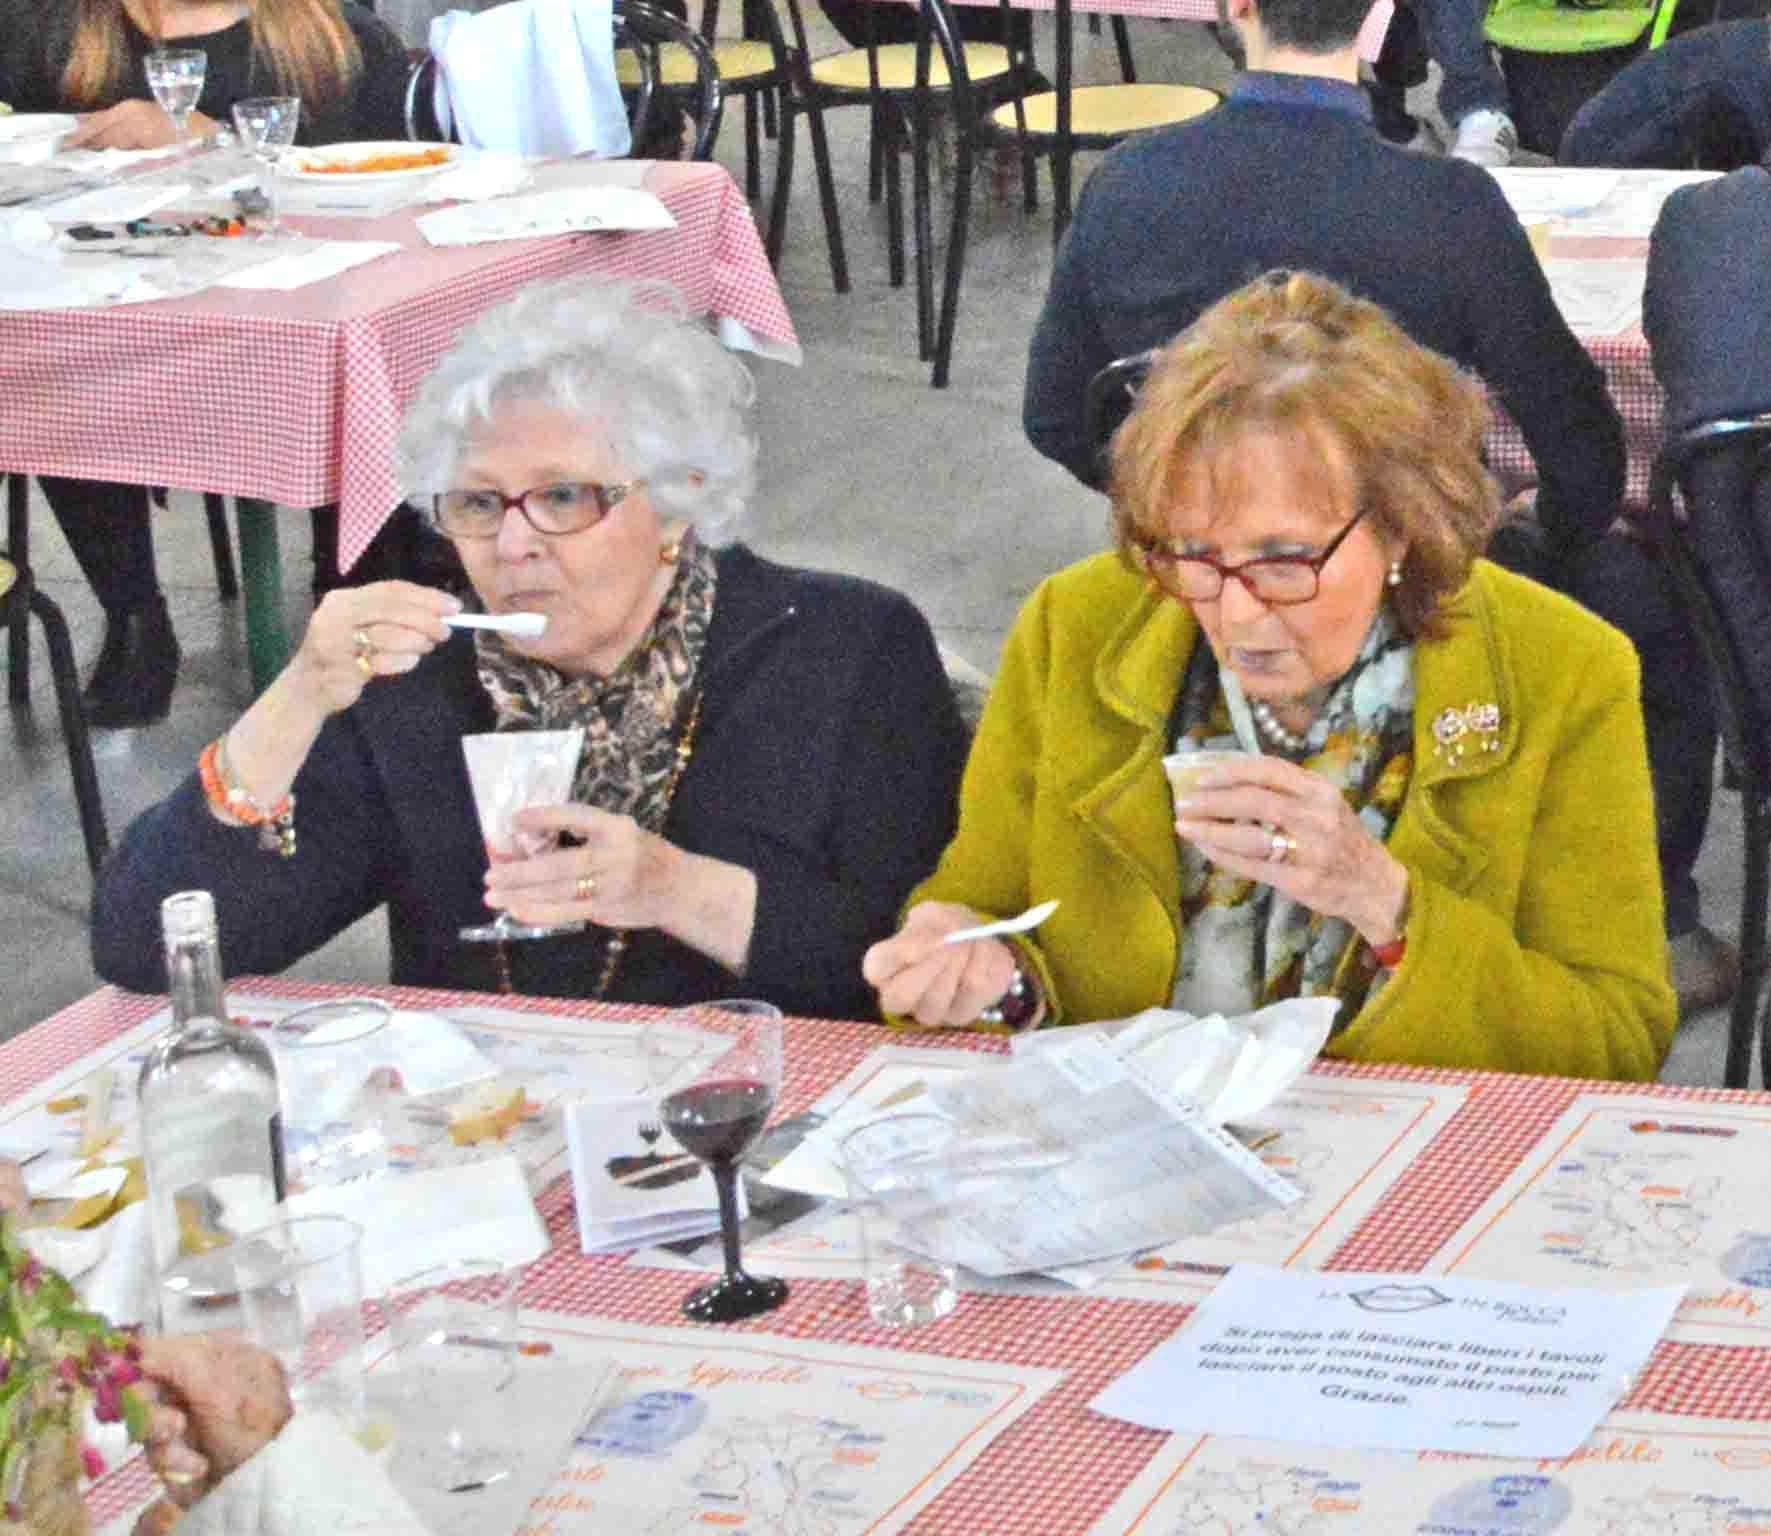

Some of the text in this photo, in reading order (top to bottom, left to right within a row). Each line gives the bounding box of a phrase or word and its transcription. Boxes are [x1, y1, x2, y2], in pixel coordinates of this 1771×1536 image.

[1199, 1342, 1262, 1356] dopo
[1265, 1346, 1319, 1357] aver
[1325, 1346, 1460, 1372] consumato
[1556, 1370, 1600, 1384] per
[1249, 1327, 1323, 1343] prega
[1328, 1328, 1354, 1341] di
[1356, 1329, 1453, 1351] lasciare
[1457, 1340, 1521, 1359] liberi
[1538, 1350, 1609, 1365] tavoli
[1197, 1359, 1296, 1373] lasciare
[1317, 1363, 1390, 1381] posto
[1392, 1372, 1440, 1388] agli
[1443, 1375, 1496, 1392] altri
